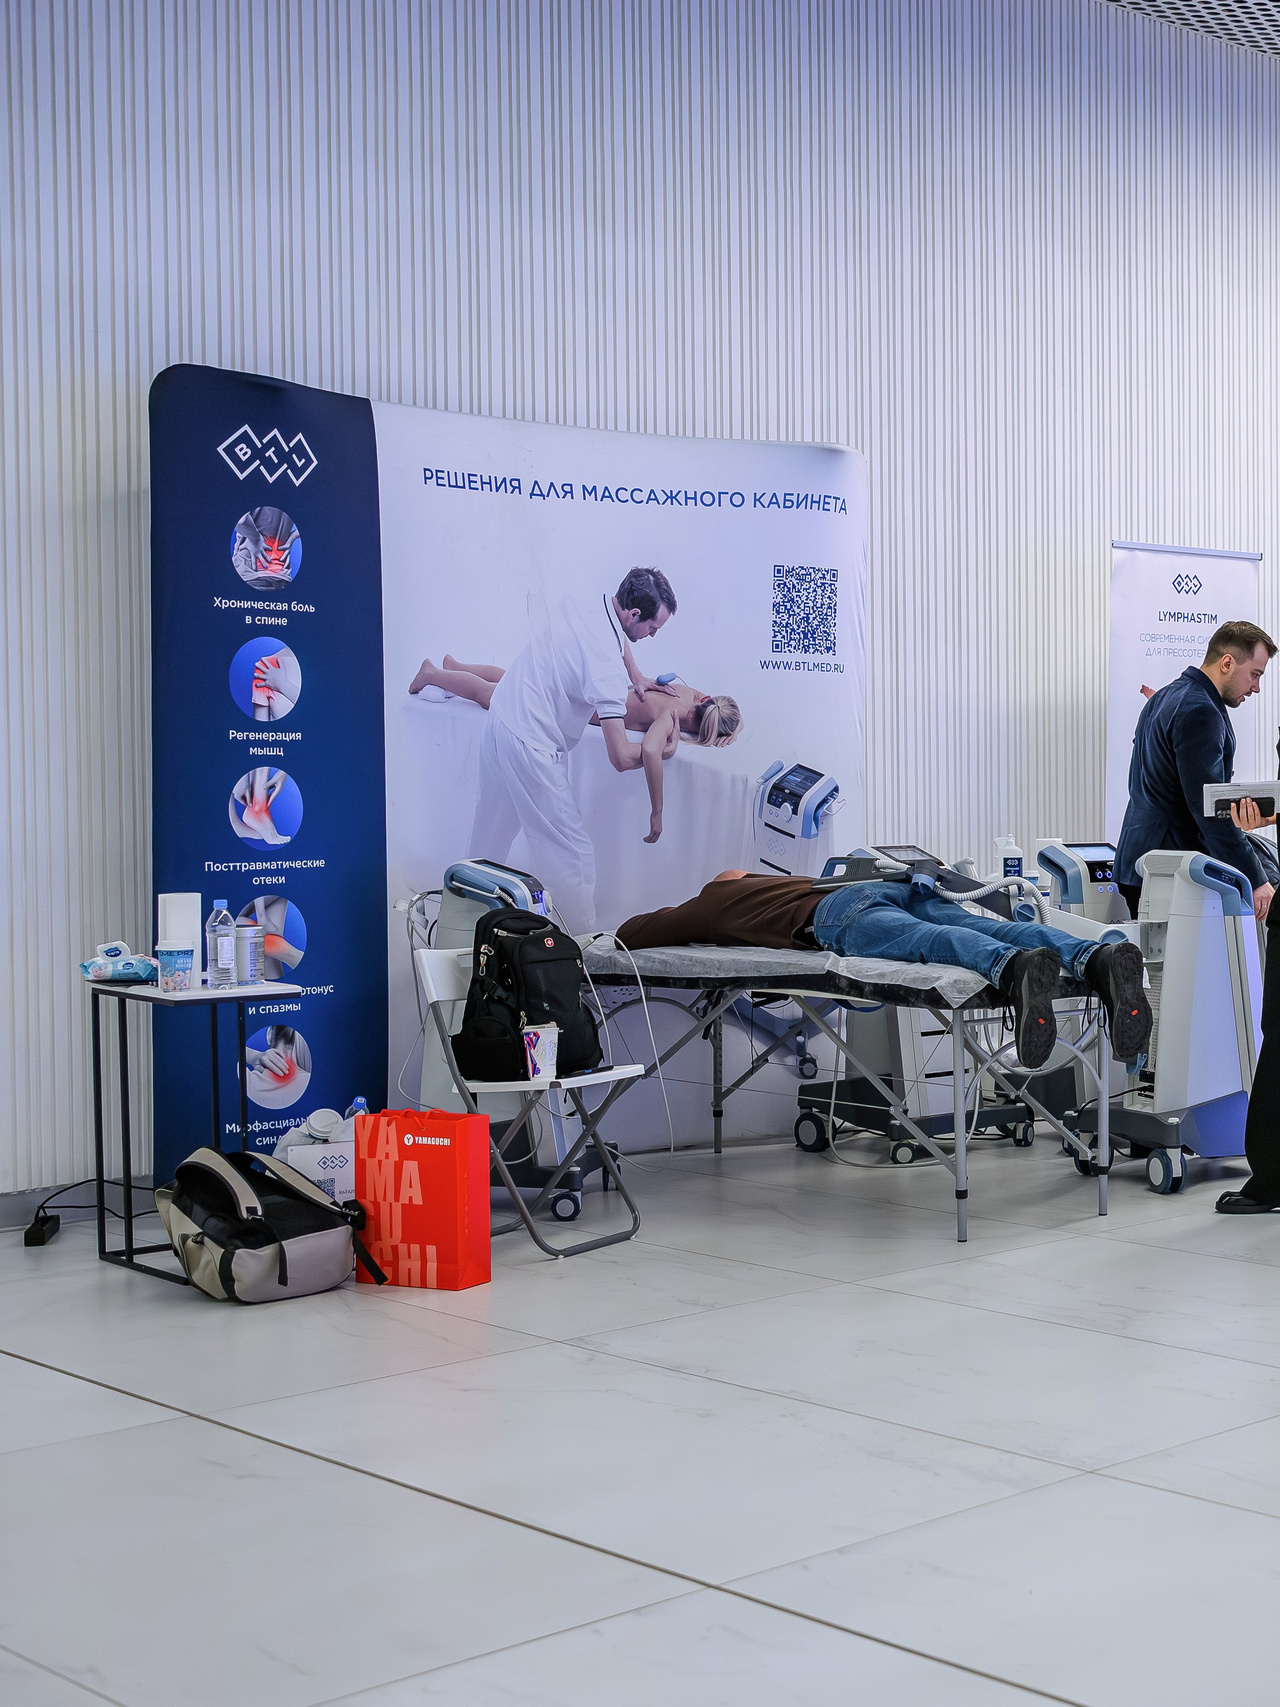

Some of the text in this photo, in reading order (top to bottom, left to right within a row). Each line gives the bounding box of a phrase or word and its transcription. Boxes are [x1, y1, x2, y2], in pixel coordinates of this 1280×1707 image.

[422, 467, 848, 515] РЕШЕНИЯ ДЛЯ МАССАЖНОГО КАБИНЕТА
[213, 597, 316, 613] Хроническая боль
[245, 614, 288, 626] в спине
[1158, 610, 1218, 625] LYMPHASTIM
[1140, 633, 1195, 644] СОВРЕМЕННАЯ
[1145, 647, 1206, 658] ДЛЯ ПРЕССОТЕР
[759, 658, 845, 674] WWW.BTLMED.RU
[229, 730, 302, 742] Регенерация
[249, 746, 284, 756] мышц
[204, 858, 326, 872] Посттравматические
[252, 875, 286, 885] отеки
[300, 984, 335, 997] ртонус
[248, 1002, 301, 1015] и спазмы
[225, 1116, 308, 1133] Миофасциаль
[414, 1136, 451, 1146] YAMAGUCHI
[365, 1160, 424, 1205] MA
